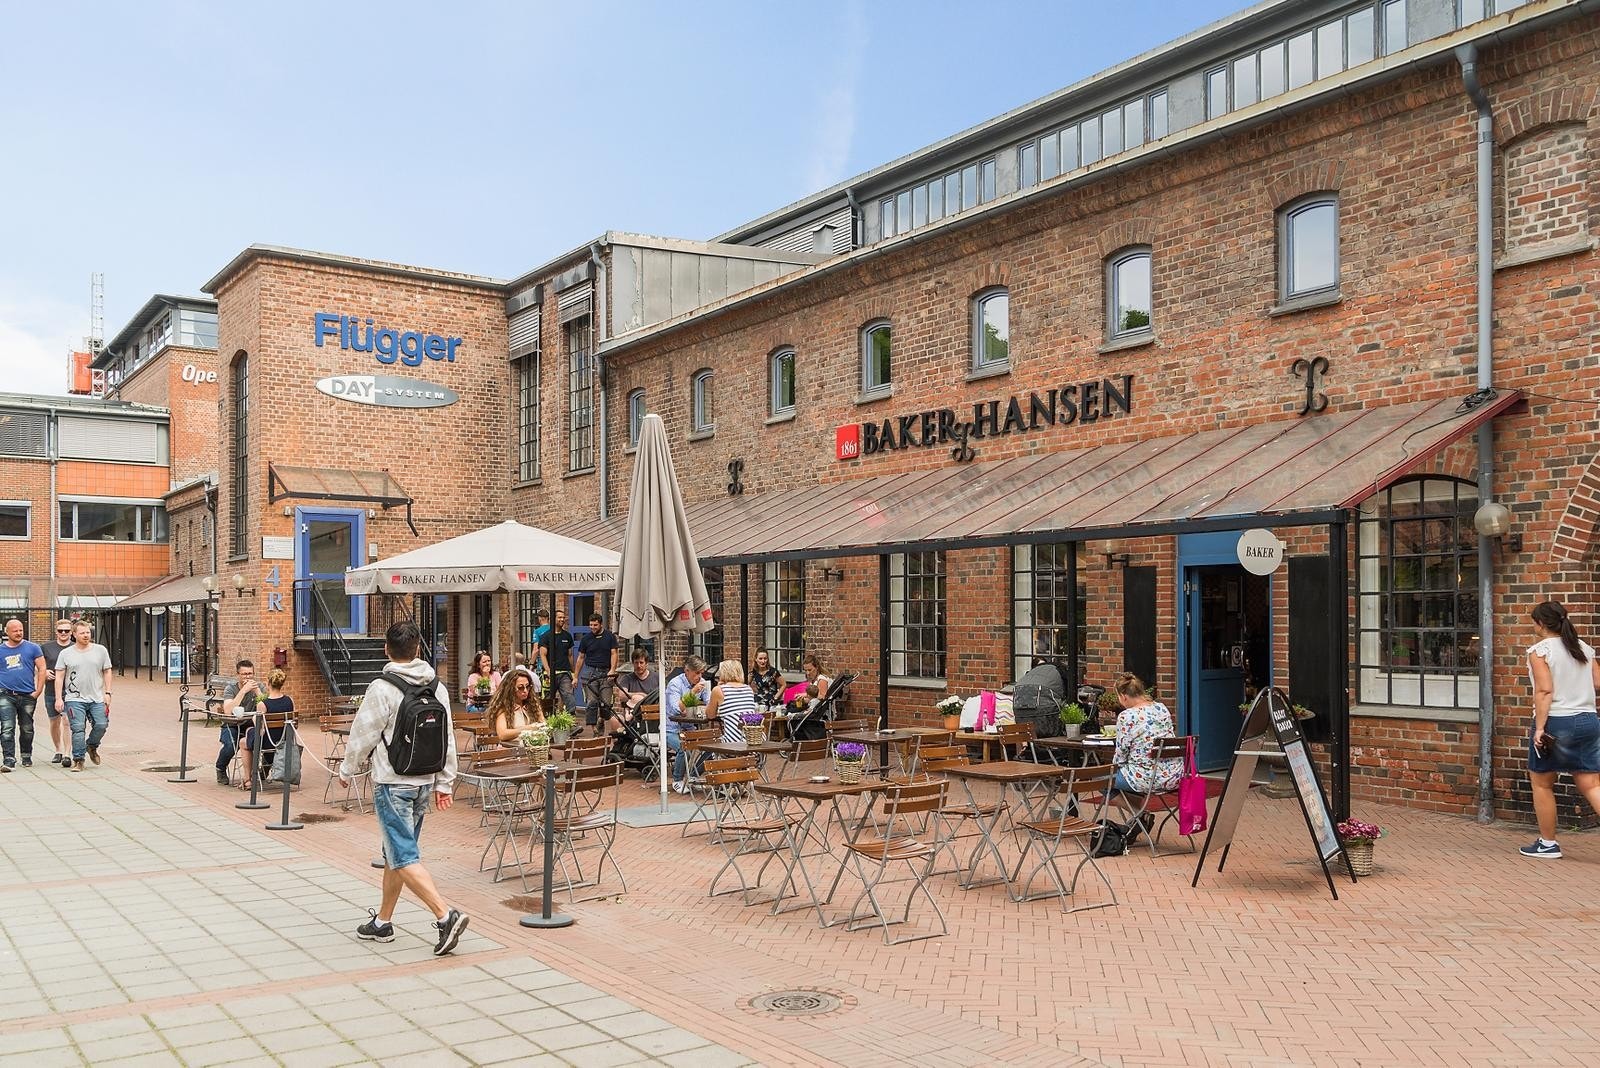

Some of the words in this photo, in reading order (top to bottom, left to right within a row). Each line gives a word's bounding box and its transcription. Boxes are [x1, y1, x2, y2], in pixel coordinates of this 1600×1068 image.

[315, 312, 462, 366] Flügger
[182, 364, 219, 387] Ope
[862, 408, 959, 455] BAKER
[972, 374, 1134, 439] HANSEN
[841, 440, 858, 456] 1861
[1246, 546, 1274, 558] BAKER
[265, 566, 281, 587] 4
[402, 574, 435, 585] BAKER
[440, 573, 487, 585] HANSEN
[528, 572, 565, 582] BAKER
[569, 572, 615, 582] HANSEN
[267, 592, 283, 611] R
